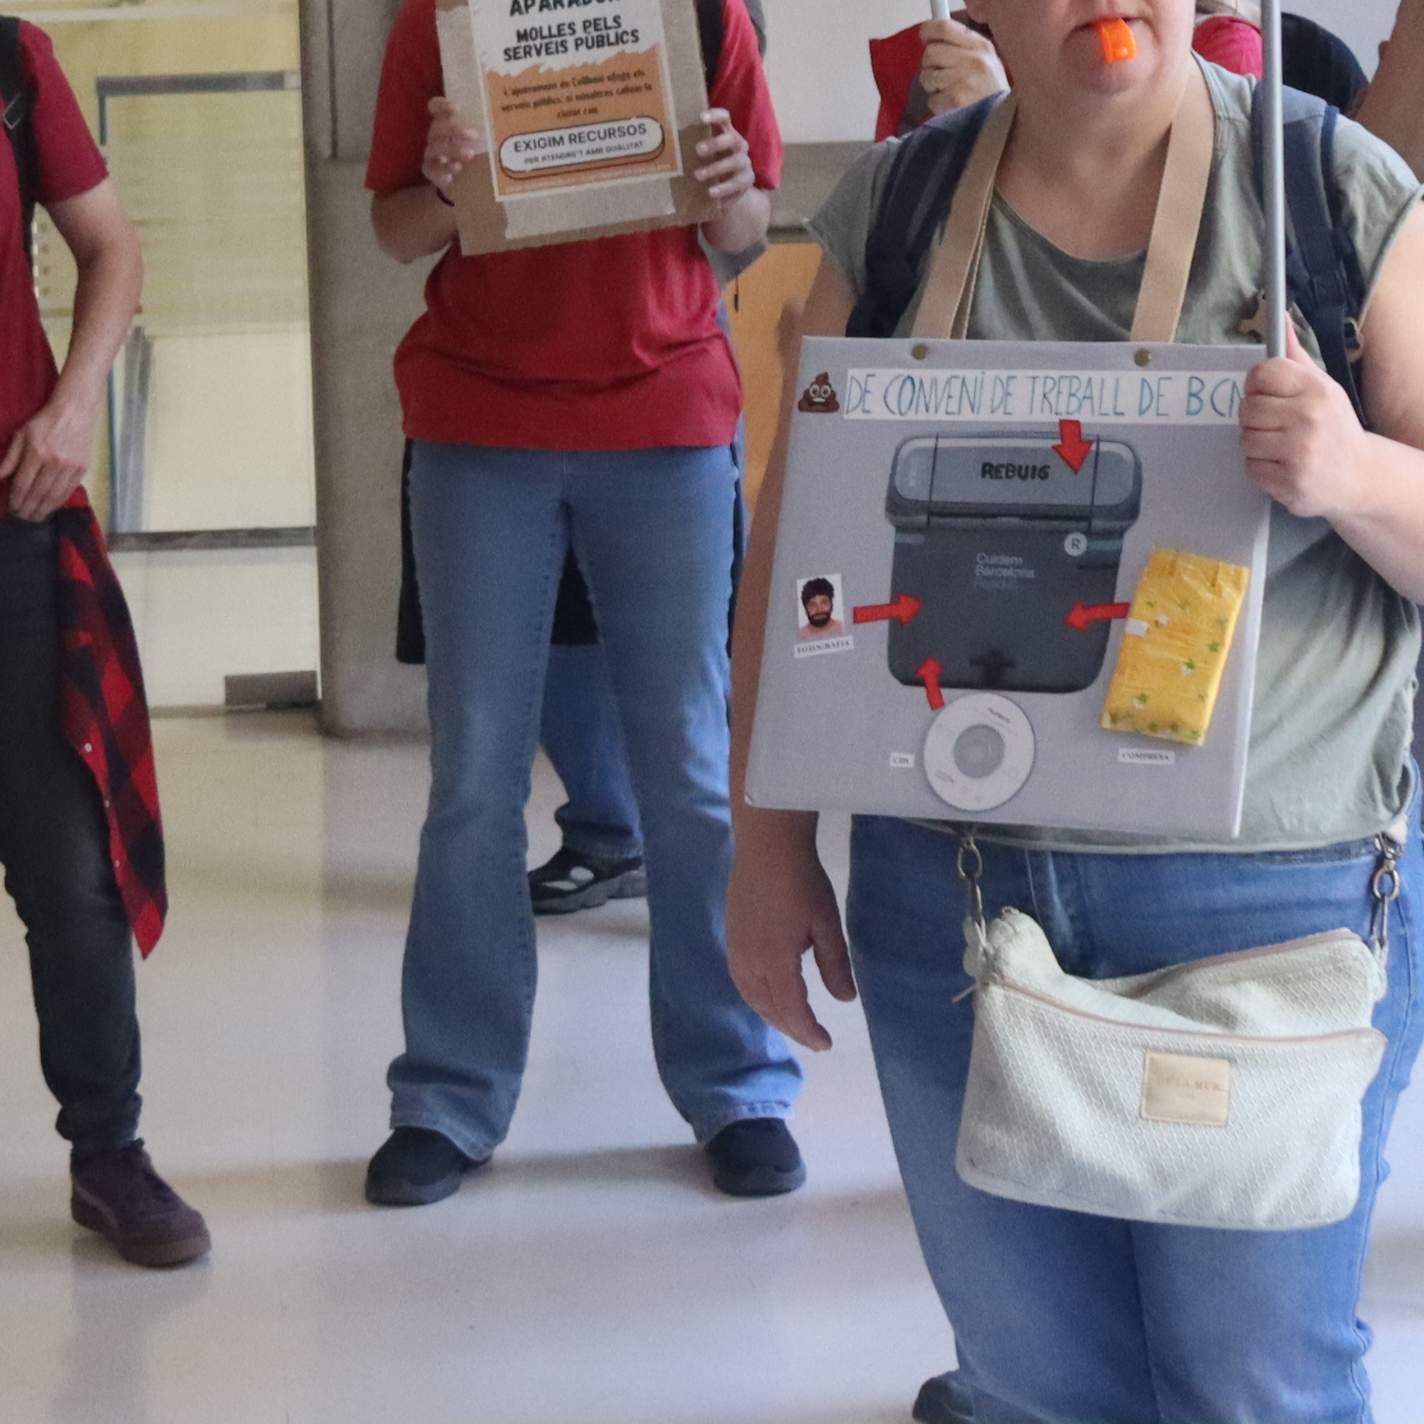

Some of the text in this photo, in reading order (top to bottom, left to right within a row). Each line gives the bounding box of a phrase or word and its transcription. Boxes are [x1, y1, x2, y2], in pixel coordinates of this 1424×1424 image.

[516, 15, 622, 44] MOLLES PELS
[503, 40, 568, 62] SERVEIS
[514, 123, 647, 152] EXIGIM RECURSOS
[845, 373, 873, 416] DE
[991, 375, 1013, 416] DE
[1029, 375, 1125, 417] TREBALL
[1138, 376, 1174, 417] DE
[980, 462, 1051, 481] REBUIG
